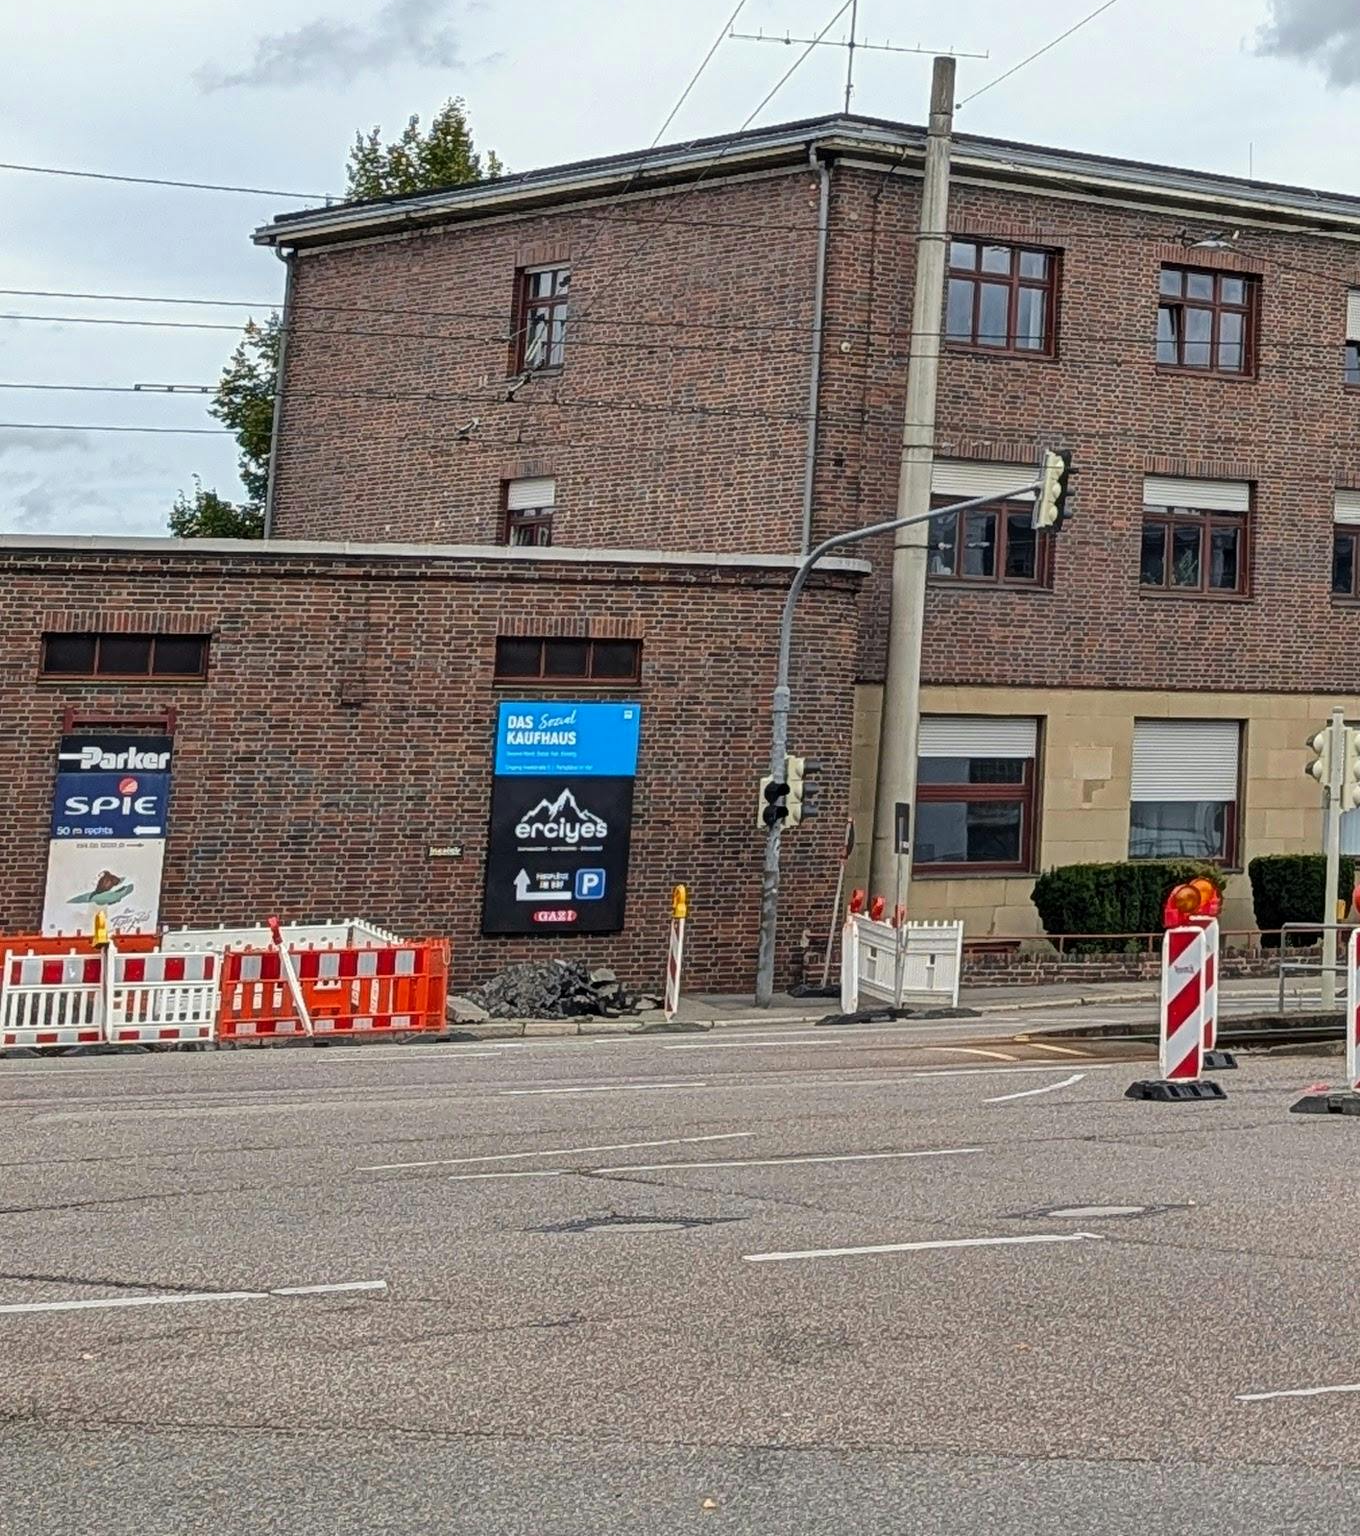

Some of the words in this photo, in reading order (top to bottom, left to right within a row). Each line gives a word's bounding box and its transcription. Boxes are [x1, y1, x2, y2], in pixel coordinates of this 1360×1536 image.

[507, 715, 534, 729] DAS
[538, 709, 577, 729] Sozial
[506, 730, 577, 745] KAUFHAUS
[80, 746, 171, 770] Parker
[56, 826, 71, 836] 50
[515, 817, 608, 843] erciyes
[582, 873, 600, 895] P
